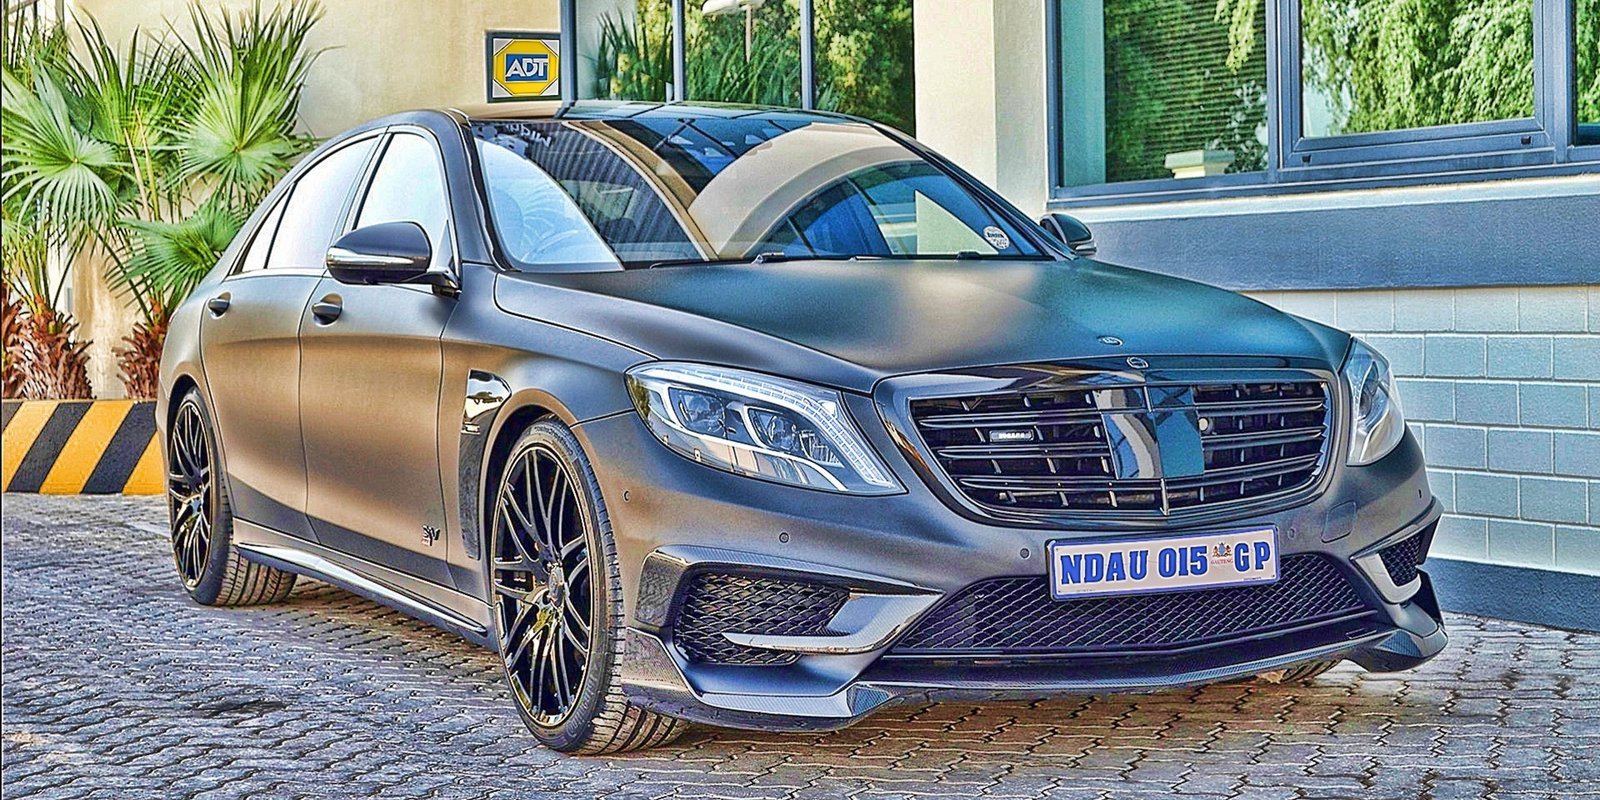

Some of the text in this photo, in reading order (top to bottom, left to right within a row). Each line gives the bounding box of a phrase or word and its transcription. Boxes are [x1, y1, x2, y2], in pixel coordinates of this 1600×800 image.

[505, 58, 549, 77] ADT
[1060, 549, 1149, 585] NDAU
[1158, 545, 1208, 578] 015
